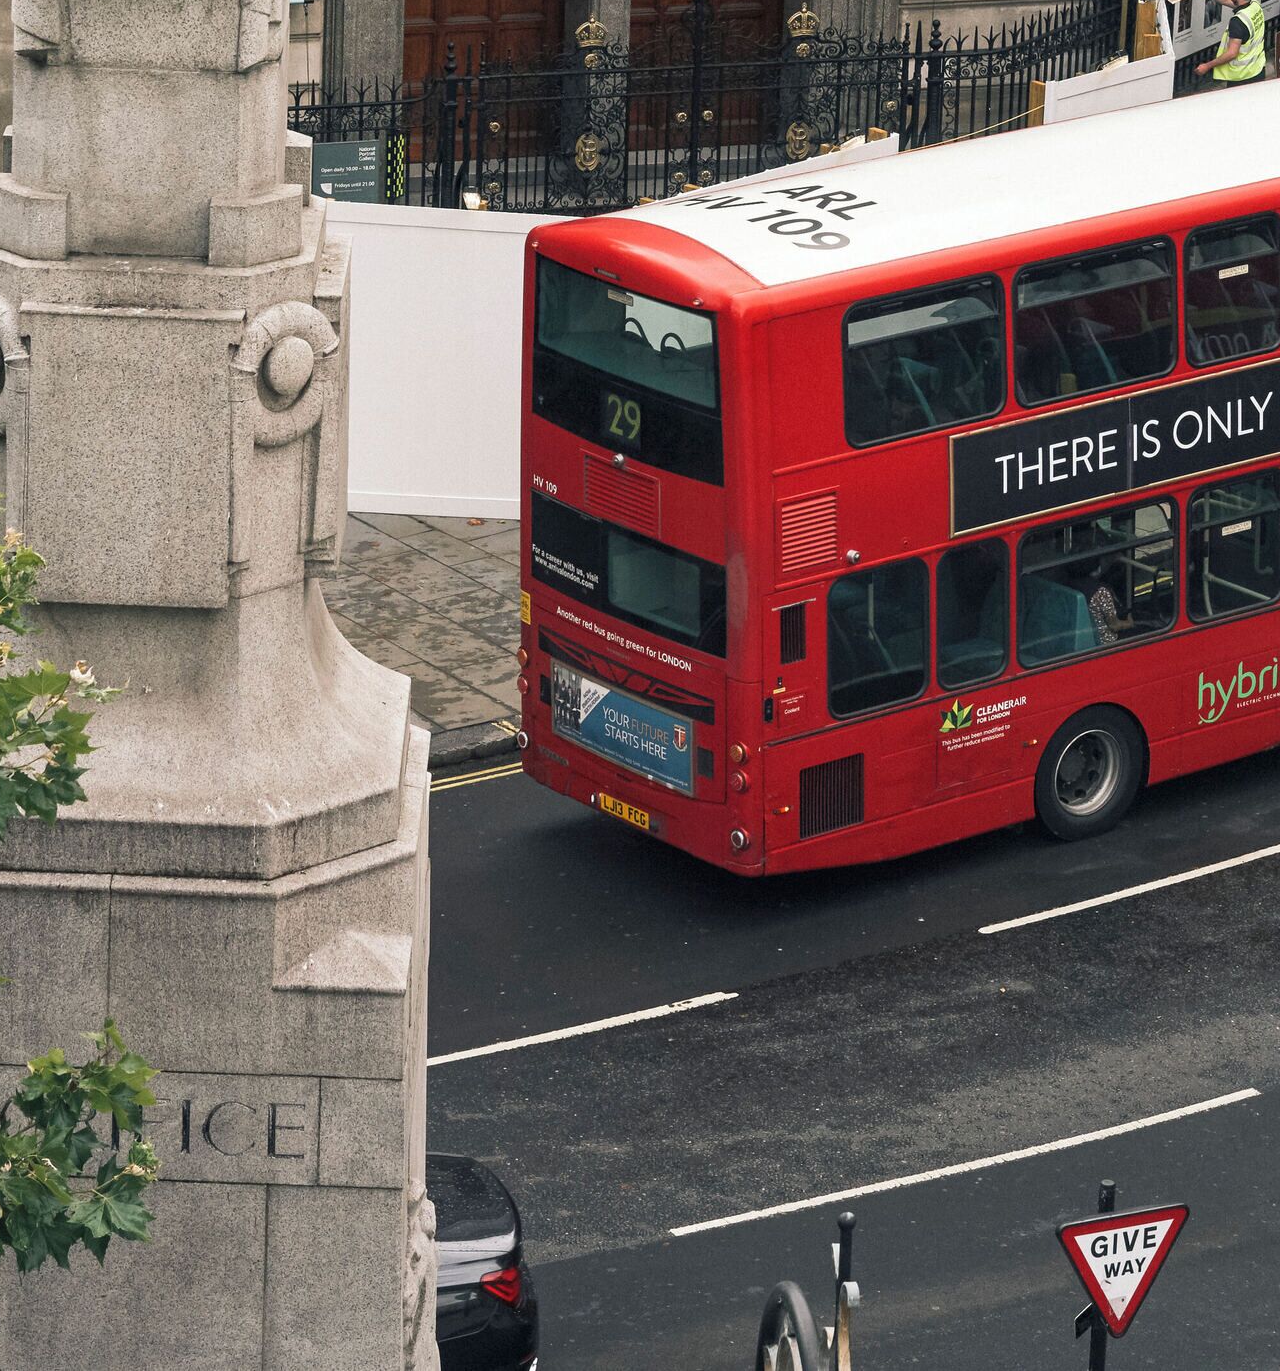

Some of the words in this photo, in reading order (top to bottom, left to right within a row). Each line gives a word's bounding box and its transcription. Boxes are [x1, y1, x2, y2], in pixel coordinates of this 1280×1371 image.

[762, 185, 878, 221] ARL
[746, 208, 851, 251] 109
[607, 394, 642, 440] 29
[994, 429, 1118, 494] THERE
[1132, 419, 1161, 462] IS
[1172, 391, 1273, 450] ONLY
[533, 473, 545, 488] HV
[545, 478, 558, 495] 109
[532, 543, 541, 555] For
[545, 552, 562, 566] career
[563, 561, 575, 573] with
[575, 567, 585, 578] us,
[586, 571, 599, 584] visit
[556, 606, 581, 625] Another
[582, 619, 593, 631] red
[593, 623, 606, 637] bus
[606, 631, 625, 647] going
[625, 639, 645, 654] green
[645, 646, 657, 658] for
[657, 651, 692, 672] LONDON
[976, 716, 988, 725] FOR
[988, 710, 1011, 721] LONDON
[1236, 696, 1262, 709] ELECTRIC
[602, 705, 630, 729] YOUR
[630, 718, 670, 746] FUTURE
[604, 723, 639, 749] STARTS
[641, 739, 668, 761] HERE
[942, 738, 952, 747] This
[952, 736, 961, 745] bus
[961, 733, 971, 741] has
[970, 730, 983, 739] been
[983, 725, 1004, 735] modified
[947, 741, 964, 751] further
[964, 738, 981, 747] reduce
[981, 732, 1005, 742] emissions
[603, 795, 624, 816] LJ13
[628, 806, 646, 826] FCG
[1090, 1226, 1158, 1258] GIVE
[1104, 1257, 1147, 1279] WAY
